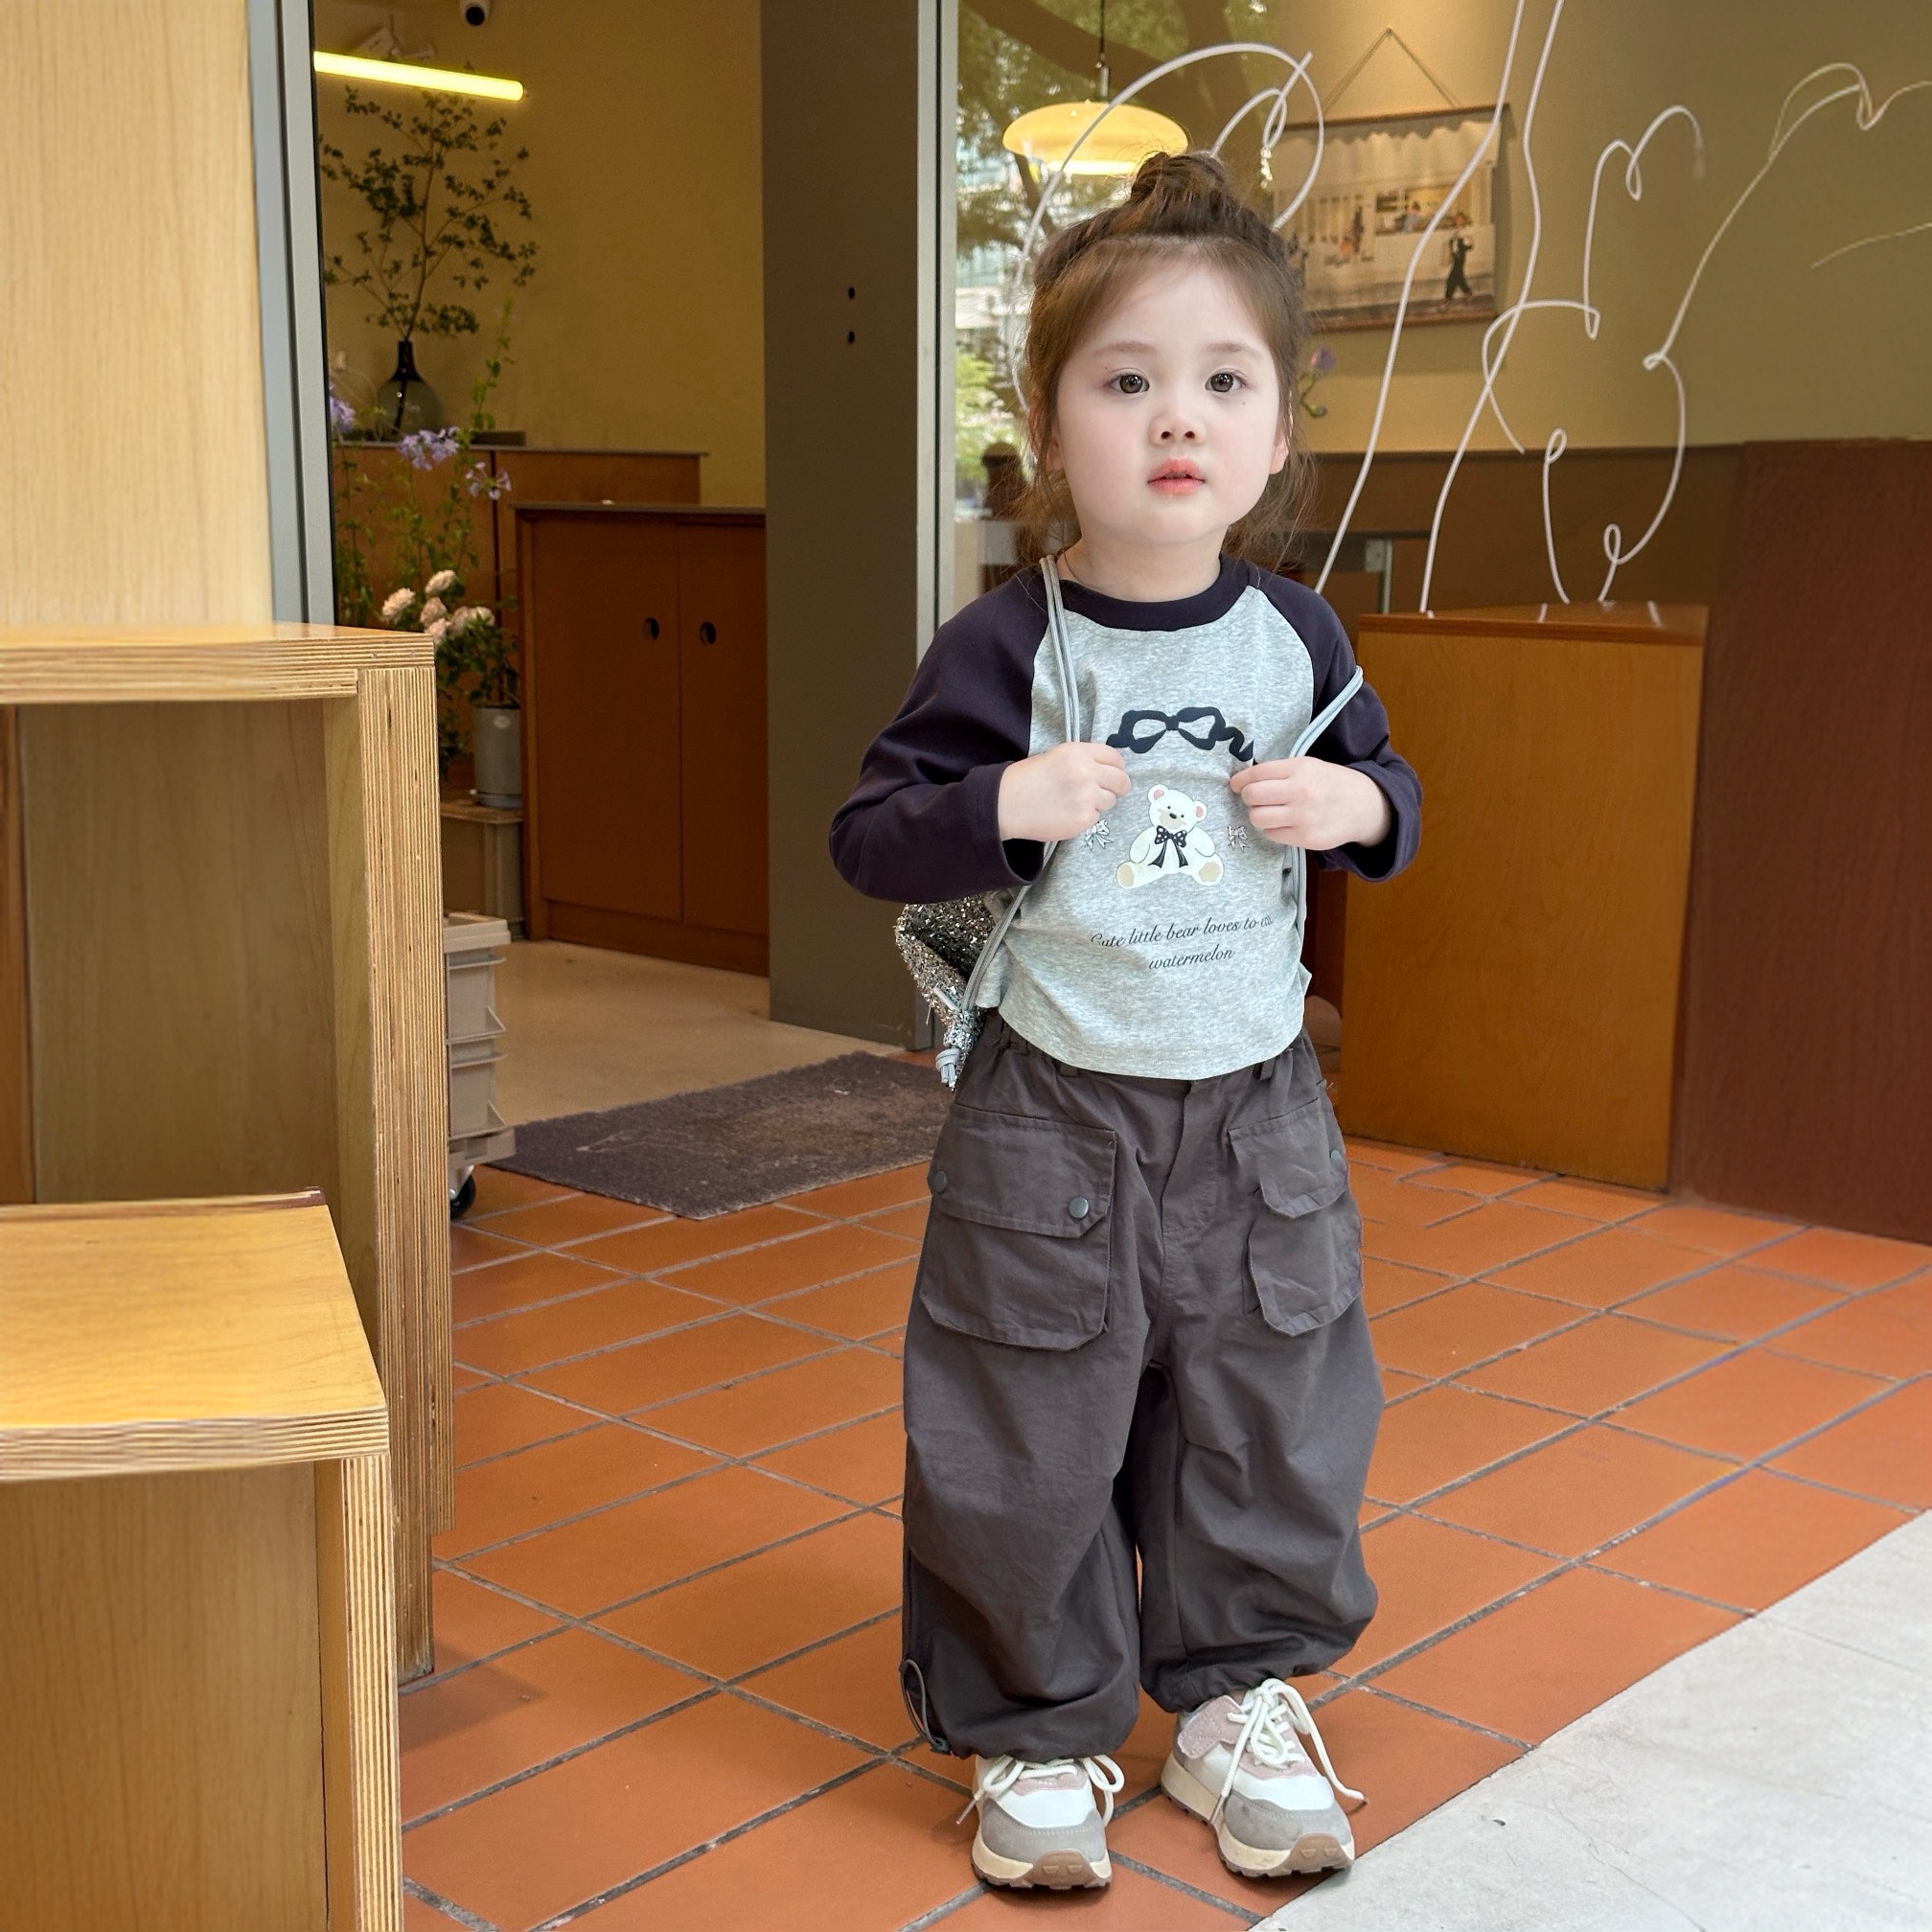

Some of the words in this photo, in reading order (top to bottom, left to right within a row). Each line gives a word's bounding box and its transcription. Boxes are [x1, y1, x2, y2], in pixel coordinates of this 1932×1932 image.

[1129, 925, 1162, 945] little
[1166, 923, 1199, 940] bear
[1204, 916, 1241, 934] loves
[1243, 917, 1258, 930] to
[1149, 943, 1234, 969] watermelon
